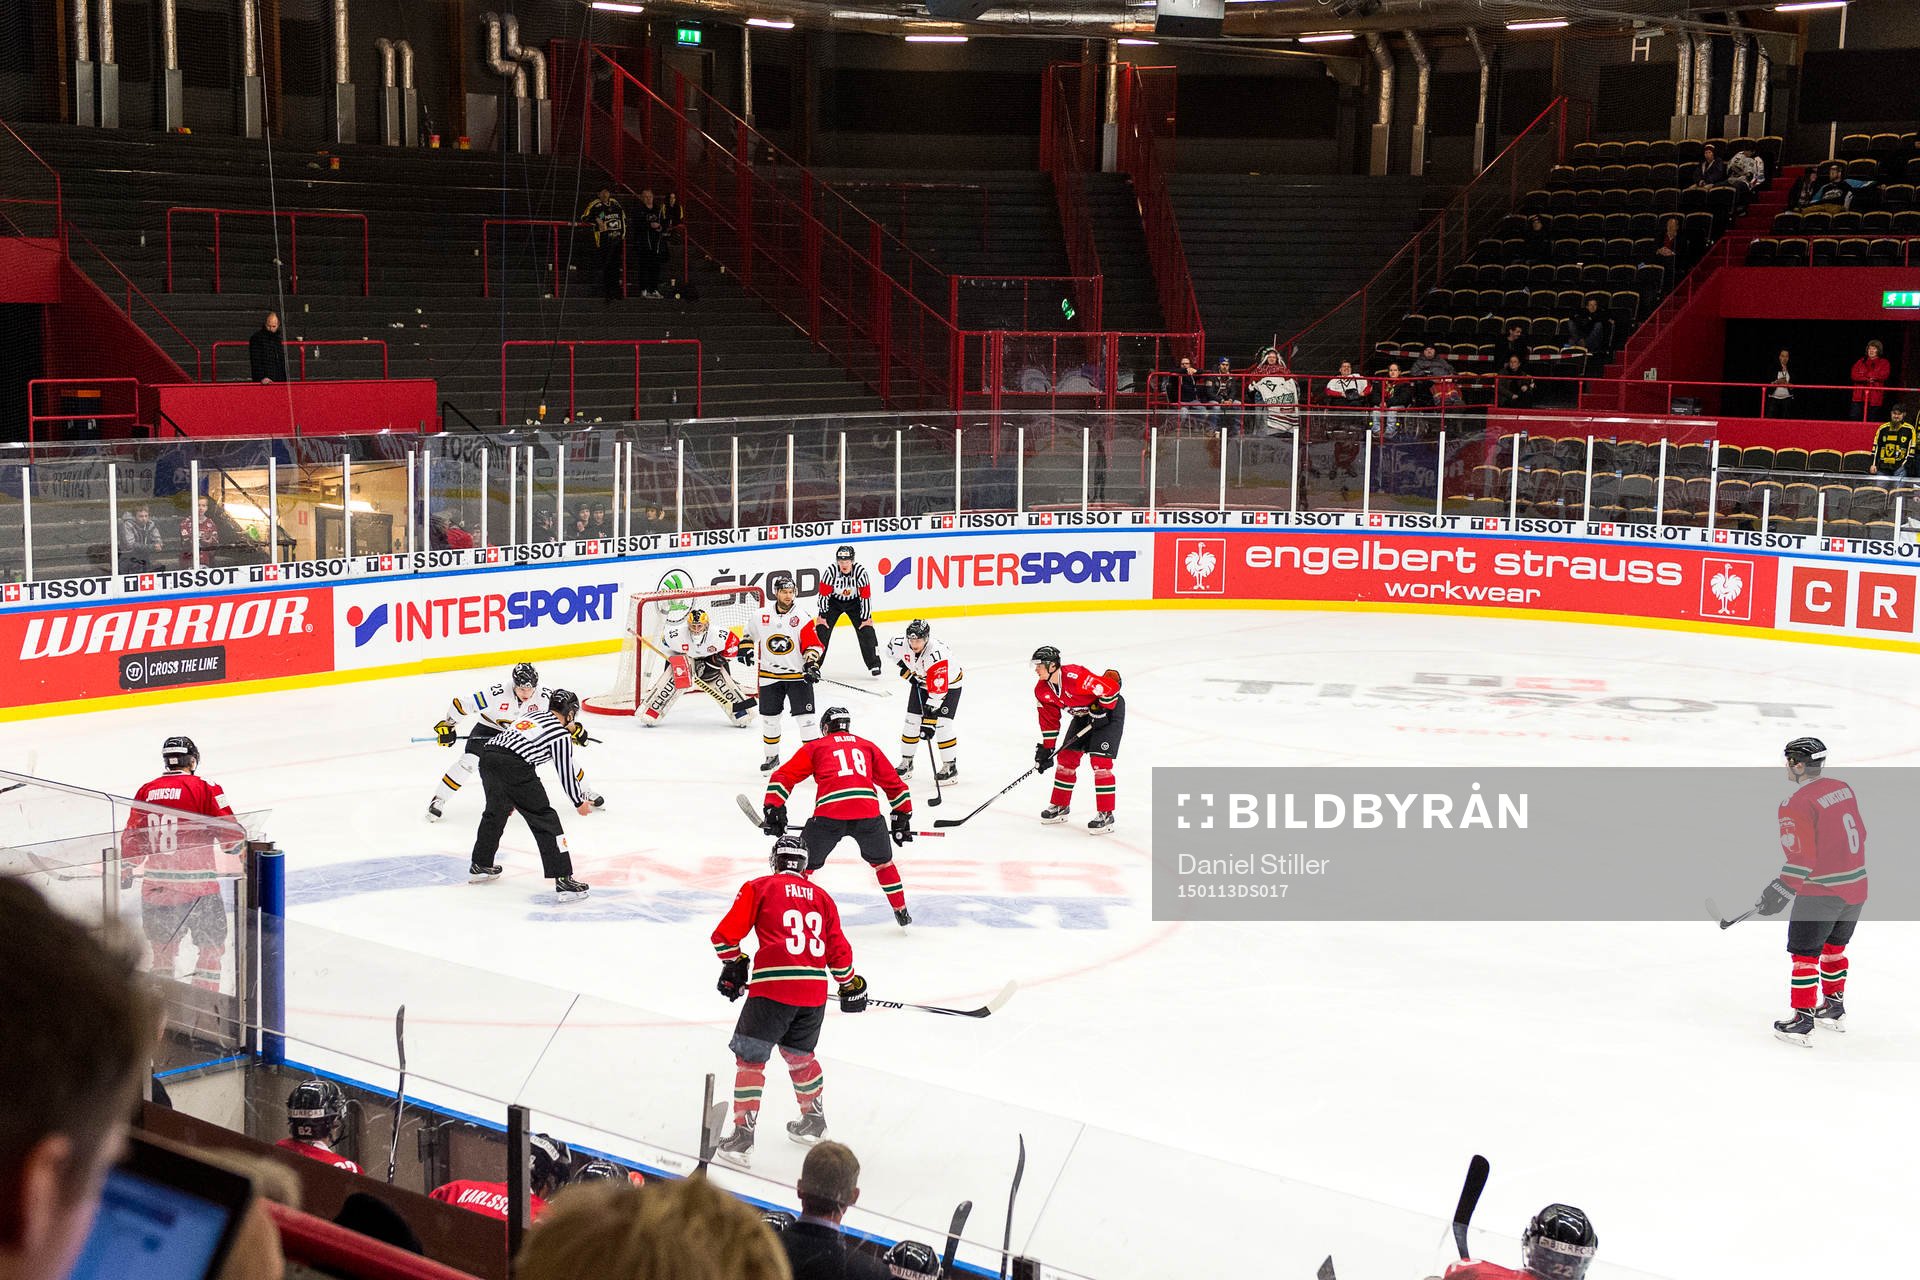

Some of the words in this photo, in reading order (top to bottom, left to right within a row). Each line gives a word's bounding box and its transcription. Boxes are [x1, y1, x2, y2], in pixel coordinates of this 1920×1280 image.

[1631, 37, 1650, 62] H
[863, 517, 922, 533] TISSOT
[955, 514, 1018, 528] TISSOT
[1054, 512, 1122, 526] TISSOT
[1159, 511, 1231, 524] TISSOT
[1270, 512, 1345, 526] TISSOT
[1385, 514, 1461, 529] TISSOT
[1500, 517, 1576, 534] TISSOT
[693, 528, 750, 546] TISSOT
[780, 522, 834, 539] TISSOT
[1616, 523, 1691, 541] TISSOT
[1730, 530, 1806, 549] TISSOT
[500, 542, 566, 561] TISSOT
[600, 535, 661, 553] TISSOT
[395, 551, 464, 570] TSSOT
[1245, 540, 1476, 576] engelbert
[1494, 549, 1682, 586] strauss
[157, 568, 238, 590] TISSOT
[917, 550, 1136, 591] INTERSPORT
[23, 577, 111, 600] TISSOT
[710, 568, 820, 608] ŠKOD
[1384, 580, 1541, 603] workwear
[1805, 580, 1833, 613] C
[1872, 585, 1898, 619] R
[395, 583, 618, 643] INTERSPORT
[19, 597, 309, 661] WARRIOR
[930, 650, 942, 663] 17
[149, 660, 179, 676] CROSS
[181, 659, 197, 673] THE
[198, 656, 219, 671] LINE
[490, 683, 504, 697] 23
[833, 748, 867, 777] 18
[146, 788, 182, 801] JOHNSON
[1842, 813, 1860, 854] 6
[786, 860, 799, 869] 33
[785, 883, 814, 901] FÄLTH
[782, 909, 826, 957] 33
[866, 999, 904, 1009] STON
[457, 1188, 509, 1216] KARLSSO
[1552, 1264, 1573, 1277] 22
